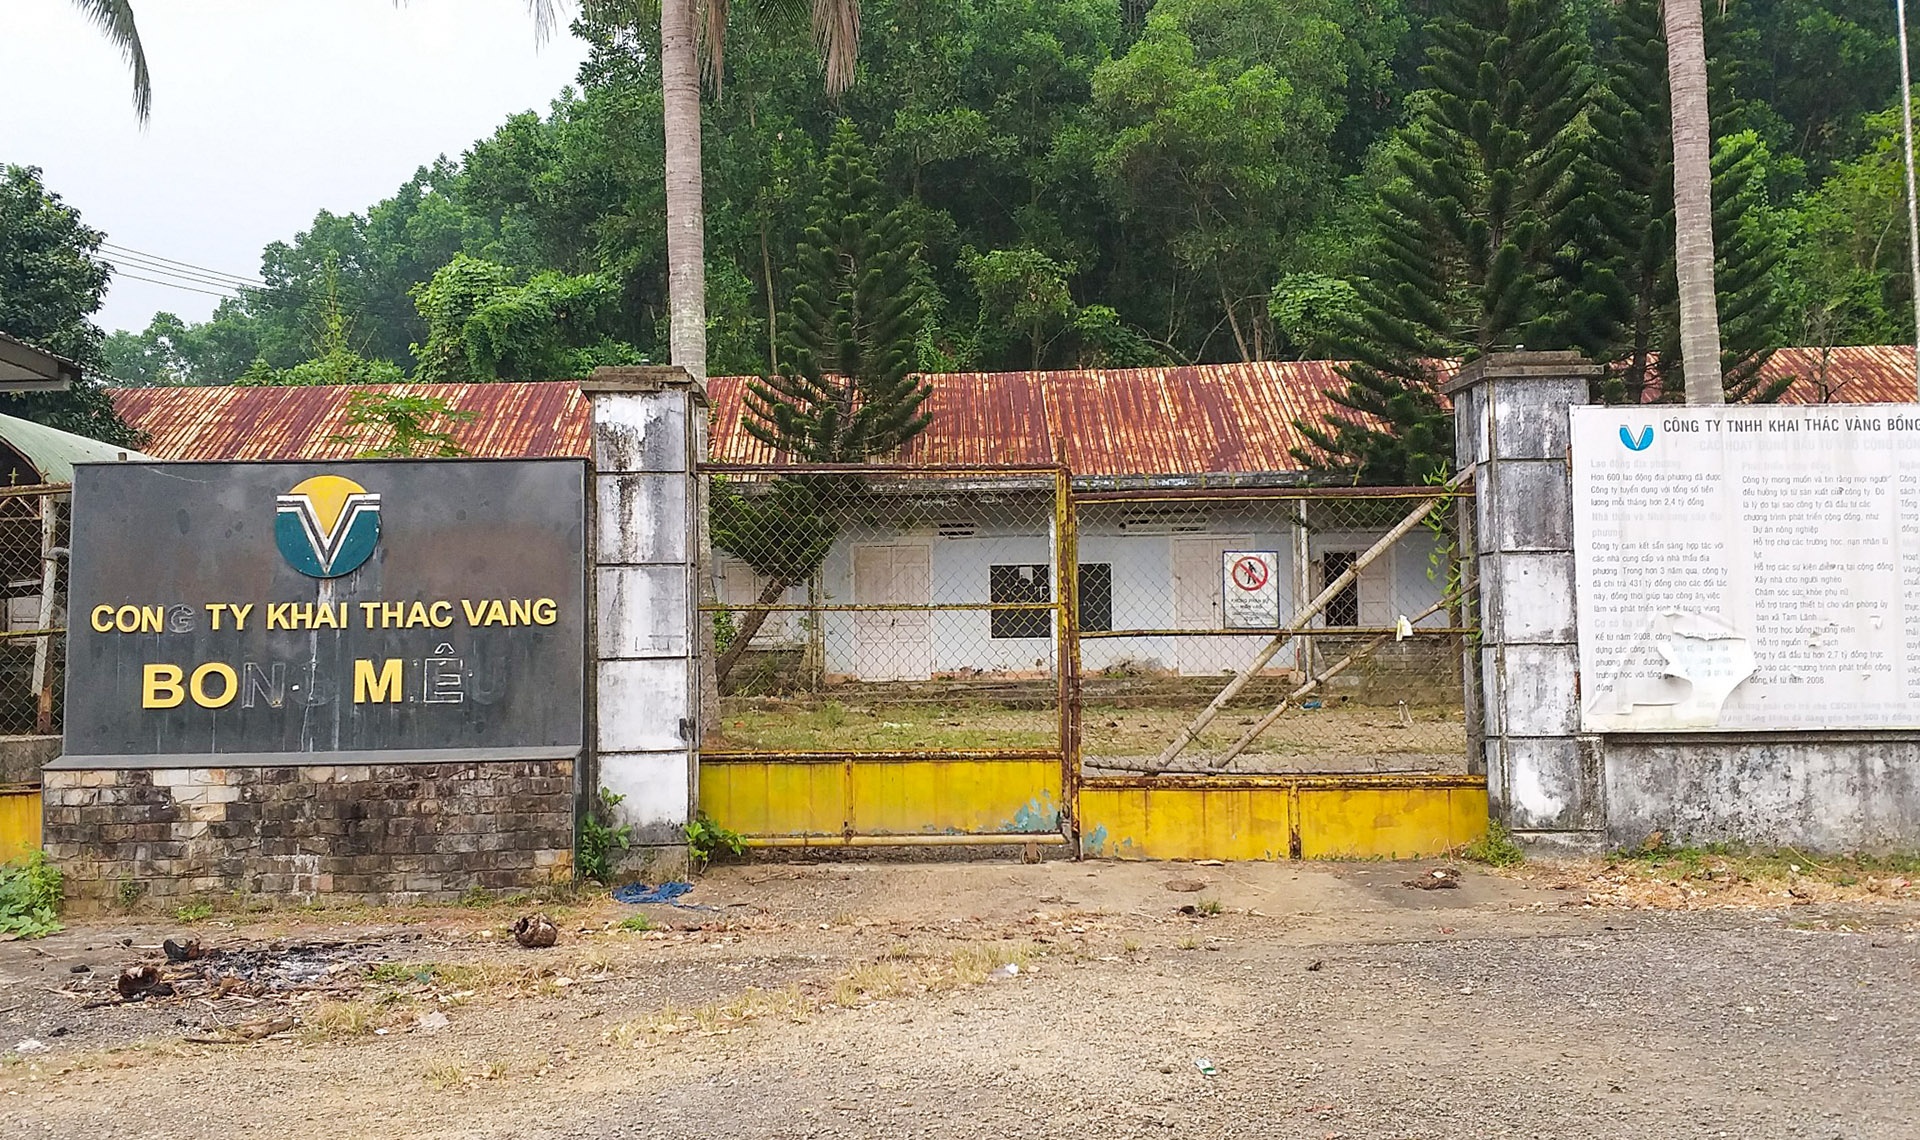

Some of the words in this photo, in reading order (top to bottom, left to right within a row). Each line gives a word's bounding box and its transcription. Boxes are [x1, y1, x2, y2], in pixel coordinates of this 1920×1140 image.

[1663, 417, 1699, 432] CÔNG
[1705, 420, 1721, 432] TY
[1727, 419, 1762, 432] TNHH
[1769, 419, 1799, 432] KHAI
[1804, 415, 1839, 431] THÁC
[1845, 415, 1881, 431] VÀNG
[1607, 473, 1620, 481] 600
[1623, 567, 1642, 576] Trong
[206, 603, 254, 631] TY
[266, 602, 349, 630] KHAI
[360, 600, 454, 629] THAC
[461, 598, 558, 627] VANG
[1807, 676, 1824, 684] 2008
